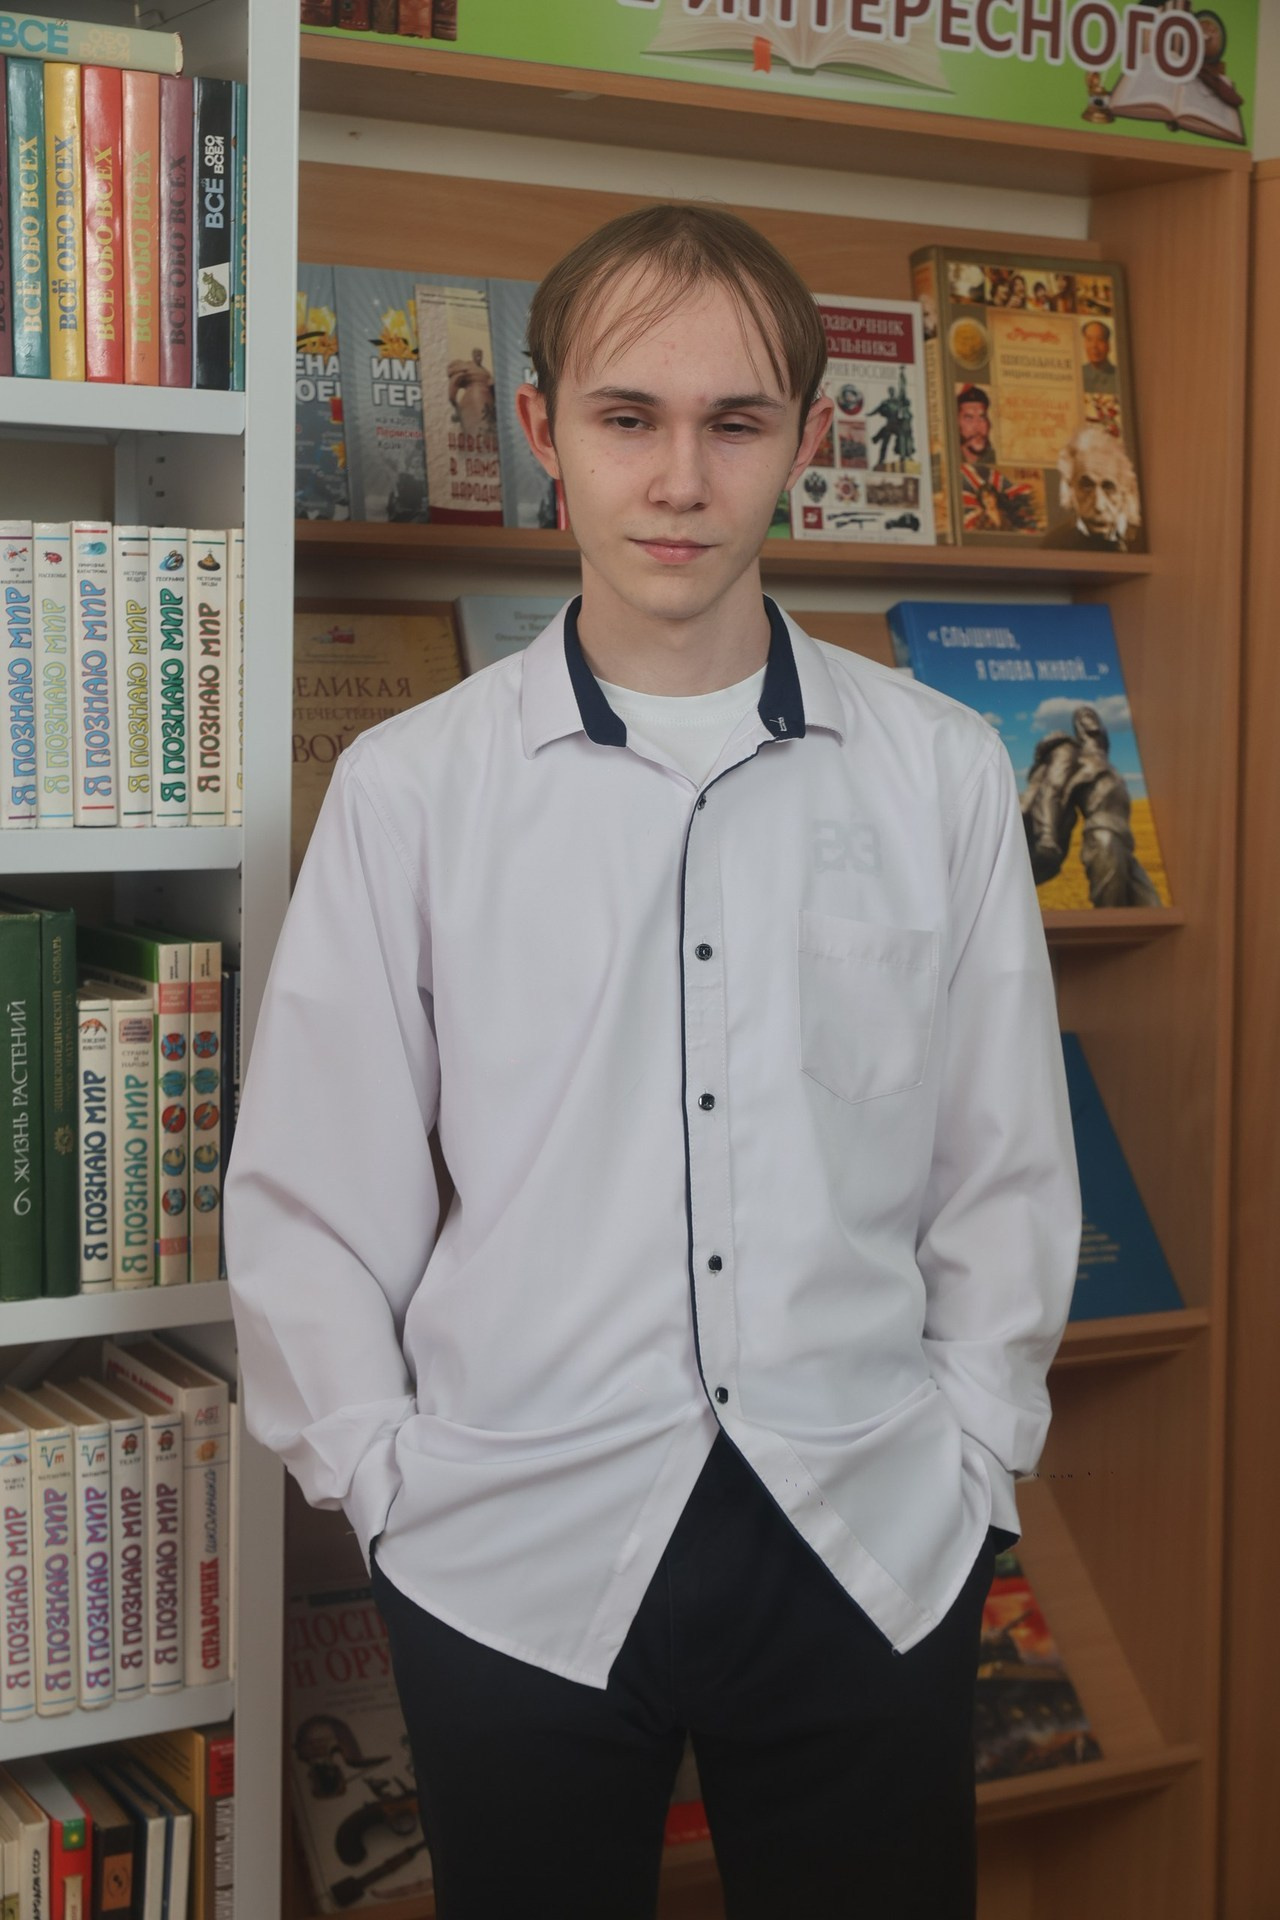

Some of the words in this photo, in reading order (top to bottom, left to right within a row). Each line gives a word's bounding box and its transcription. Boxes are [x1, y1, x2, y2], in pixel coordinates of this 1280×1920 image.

[684, 0, 1199, 78] ЕРЕСНОГО
[18, 136, 40, 209] ВСЕХ
[54, 135, 75, 208] ВСЕХ
[204, 134, 215, 167] ОБО
[213, 135, 224, 174] ВСЕМ
[94, 146, 113, 217] ВСЕХ
[132, 150, 151, 221] ВСЕХ
[20, 215, 41, 274] ОБО
[56, 215, 76, 272] ОБО
[94, 223, 114, 282] ОБО
[132, 228, 151, 285] ОБО
[16, 280, 43, 333] ВСЁ
[52, 279, 78, 332] ВСЁ
[371, 357, 420, 381] ИМ
[5, 587, 32, 649] МИР
[42, 598, 66, 654] МИР
[80, 579, 107, 641] МИР
[125, 600, 147, 655] МИР
[159, 588, 183, 652] МИР
[198, 602, 220, 657] МИР
[43, 662, 68, 768] ПОЗНАЮ
[81, 650, 110, 768] ПОЗНАЮ
[126, 662, 148, 768] ПОЗНАЮ
[293, 677, 412, 698] ЕЛИКАЯ
[8, 657, 36, 777] ПОЗНАЮ
[160, 658, 185, 776] ПОЗНАЮ
[198, 664, 220, 769] ПОЗНАЮ
[11, 782, 36, 806] Я
[44, 775, 70, 794] Я
[83, 774, 112, 796] Я
[127, 775, 149, 793] Я
[160, 782, 187, 803] Я
[197, 775, 220, 793] Я
[52, 936, 62, 984] СЛОВАРЬ
[7, 1000, 29, 1106] РАСТЕНИЙ
[83, 1069, 107, 1125] МИР
[125, 1074, 149, 1132] МИР
[13, 1113, 31, 1184] ЖИЗНЬ
[84, 1131, 108, 1236] ПОЗНАЮ
[124, 1137, 148, 1250] ПОЗНАЮ
[84, 1240, 108, 1261] Я
[121, 1253, 148, 1274] Я
[4, 1505, 28, 1559] МИР
[43, 1487, 69, 1548] МИР
[85, 1486, 108, 1547] МИР
[120, 1486, 143, 1540] МИР
[155, 1482, 179, 1536] МИР
[5, 1564, 31, 1666] ПОЗНАЮ
[45, 1553, 71, 1666] ПОЗНАЮ
[86, 1550, 110, 1665] ПОЗНАЮ
[120, 1544, 143, 1647] ПОЗНАЮ
[155, 1540, 179, 1642] ПОЗНАЮ
[200, 1557, 221, 1671] СПРАВОЧНИК
[6, 1670, 31, 1690] Я
[45, 1671, 72, 1692] Я
[86, 1669, 111, 1690] Я
[120, 1651, 143, 1670] Я
[154, 1645, 178, 1666] Я
